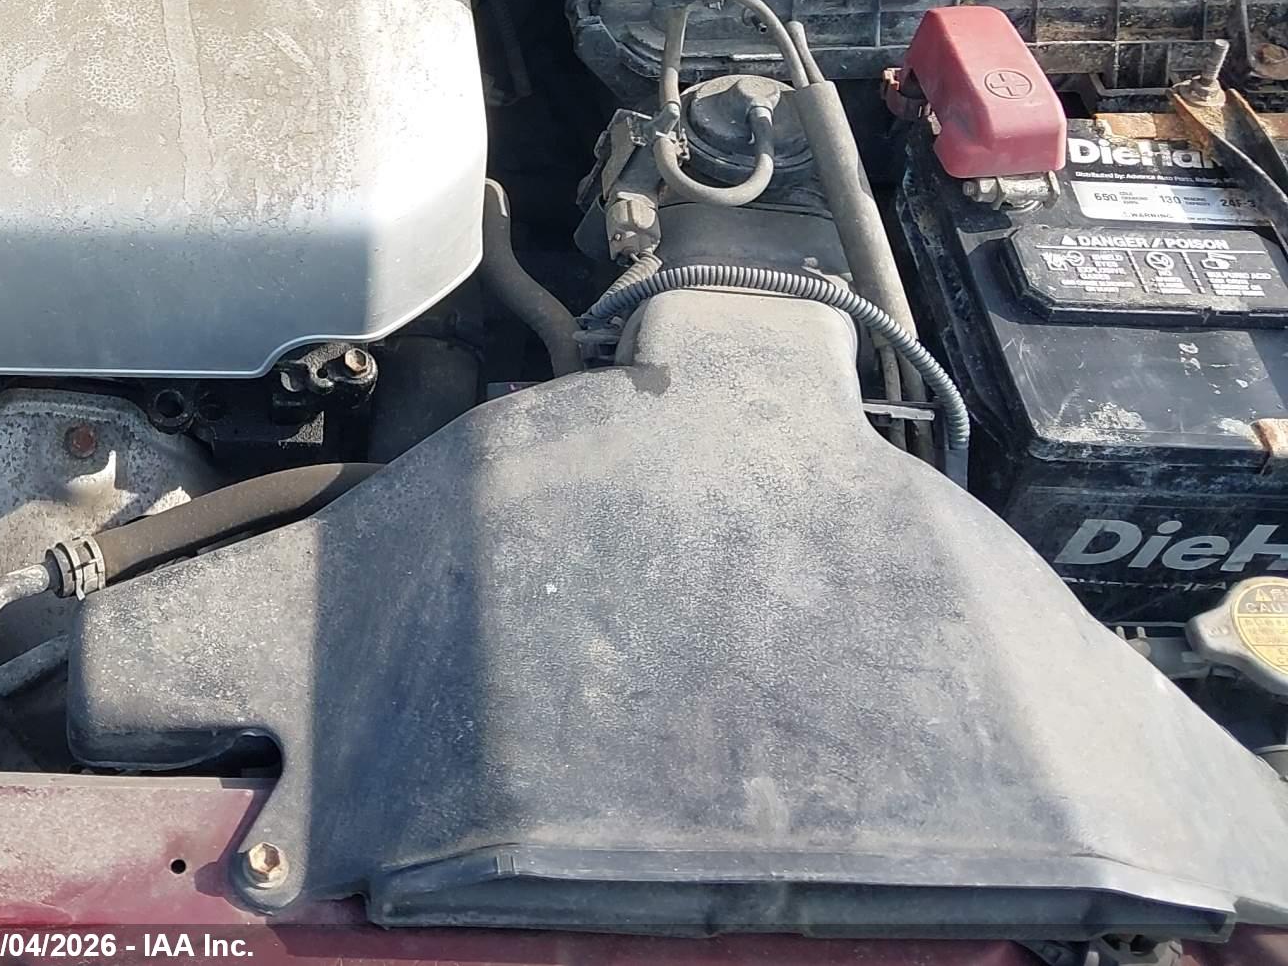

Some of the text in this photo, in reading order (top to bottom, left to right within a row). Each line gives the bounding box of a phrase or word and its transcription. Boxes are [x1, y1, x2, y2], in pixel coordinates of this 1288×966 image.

[1094, 192, 1118, 202] 650
[1159, 195, 1182, 204] 130
[1077, 235, 1150, 248] DANGER
[1165, 238, 1230, 250] POISON
